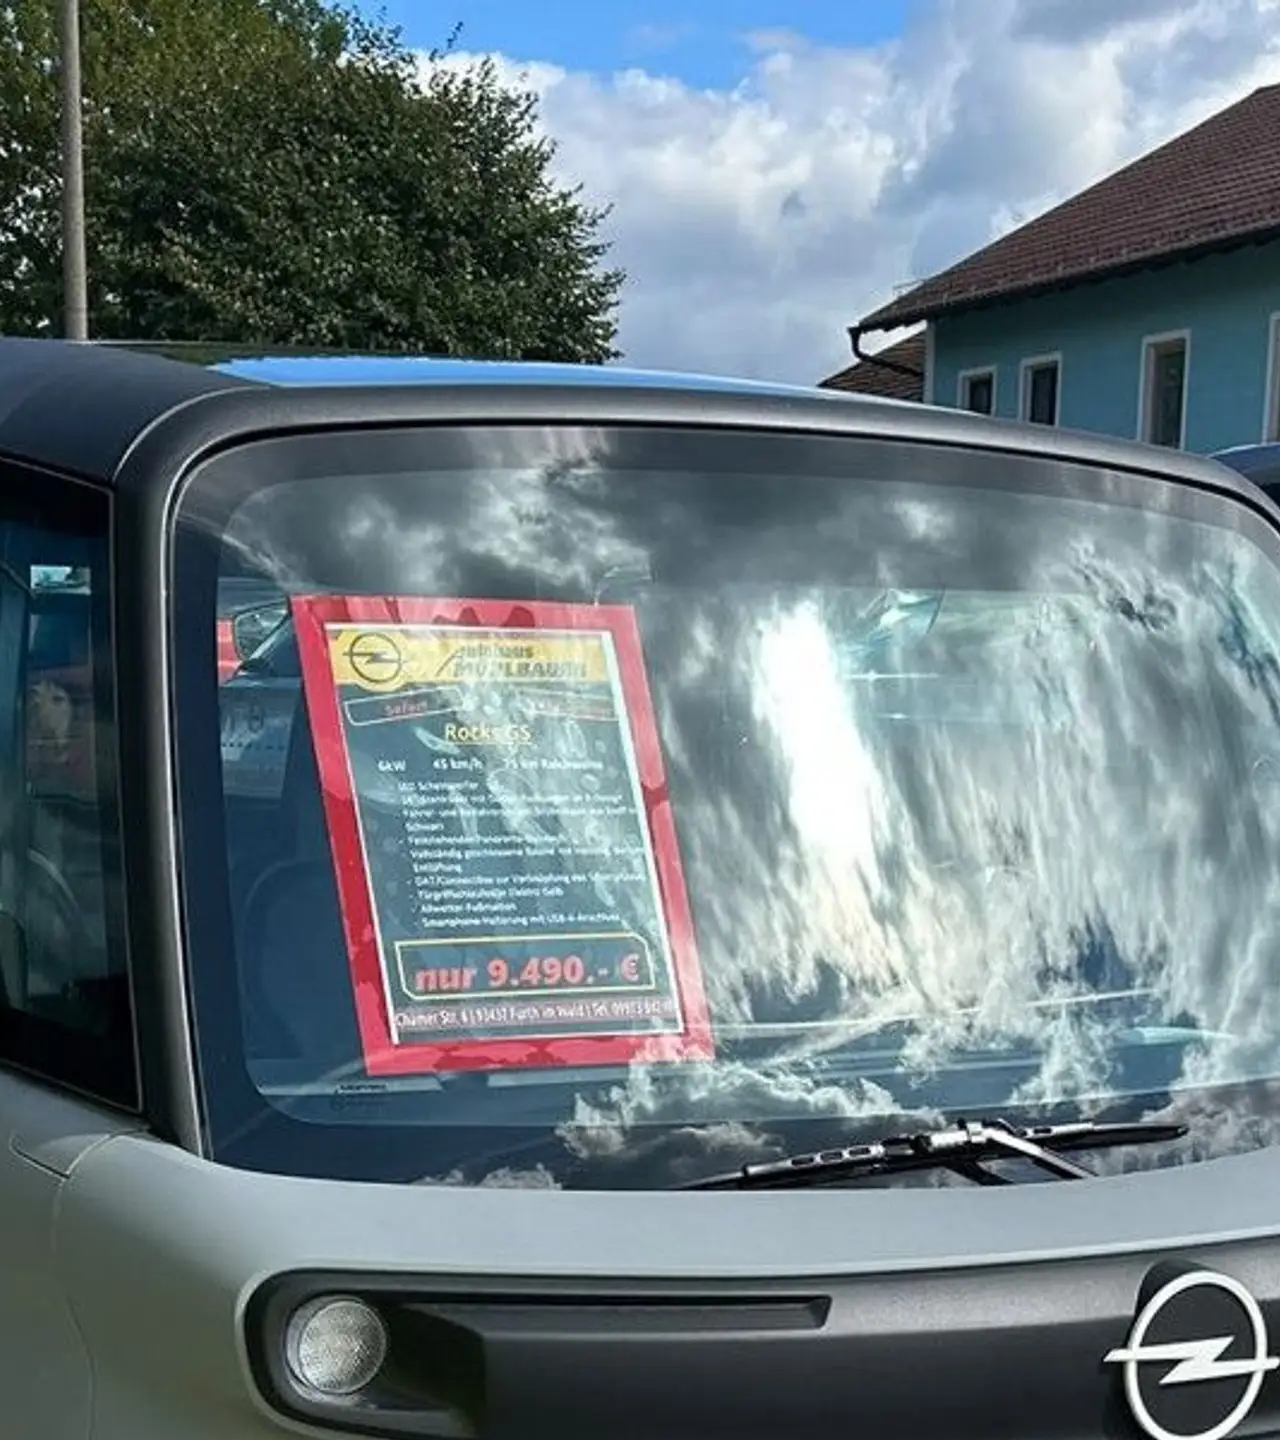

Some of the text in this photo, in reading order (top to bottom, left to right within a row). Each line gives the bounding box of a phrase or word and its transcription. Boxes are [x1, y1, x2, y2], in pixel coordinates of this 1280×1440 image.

[507, 724, 532, 741] GS
[450, 757, 485, 772] km/h
[415, 966, 478, 992] nur
[621, 953, 640, 983] €
